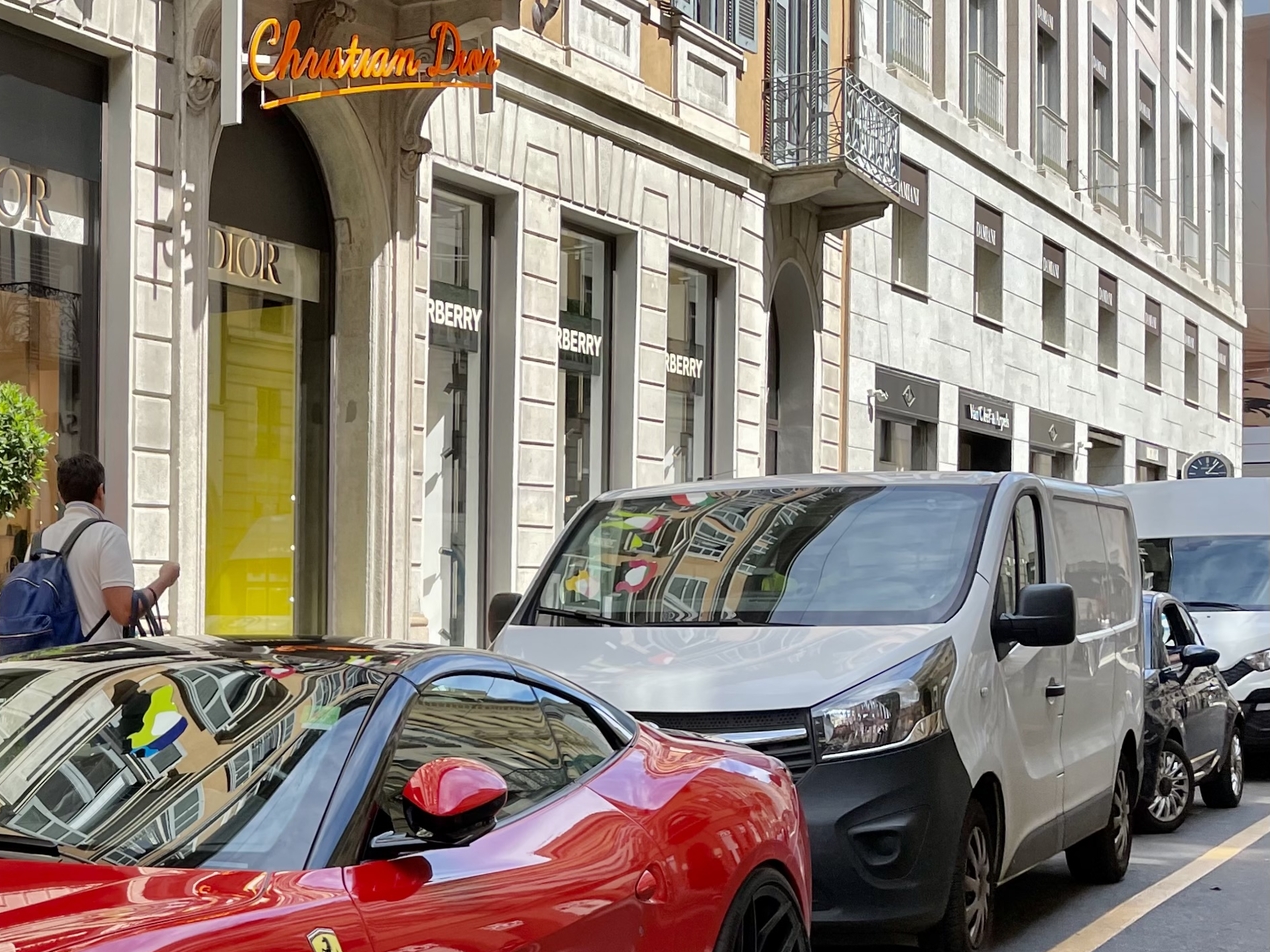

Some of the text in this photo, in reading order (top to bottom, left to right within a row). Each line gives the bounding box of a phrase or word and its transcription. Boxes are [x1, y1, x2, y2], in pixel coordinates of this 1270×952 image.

[248, 17, 501, 81] Christian Dior
[899, 181, 920, 206] AMIANI
[208, 227, 281, 285] DIOR
